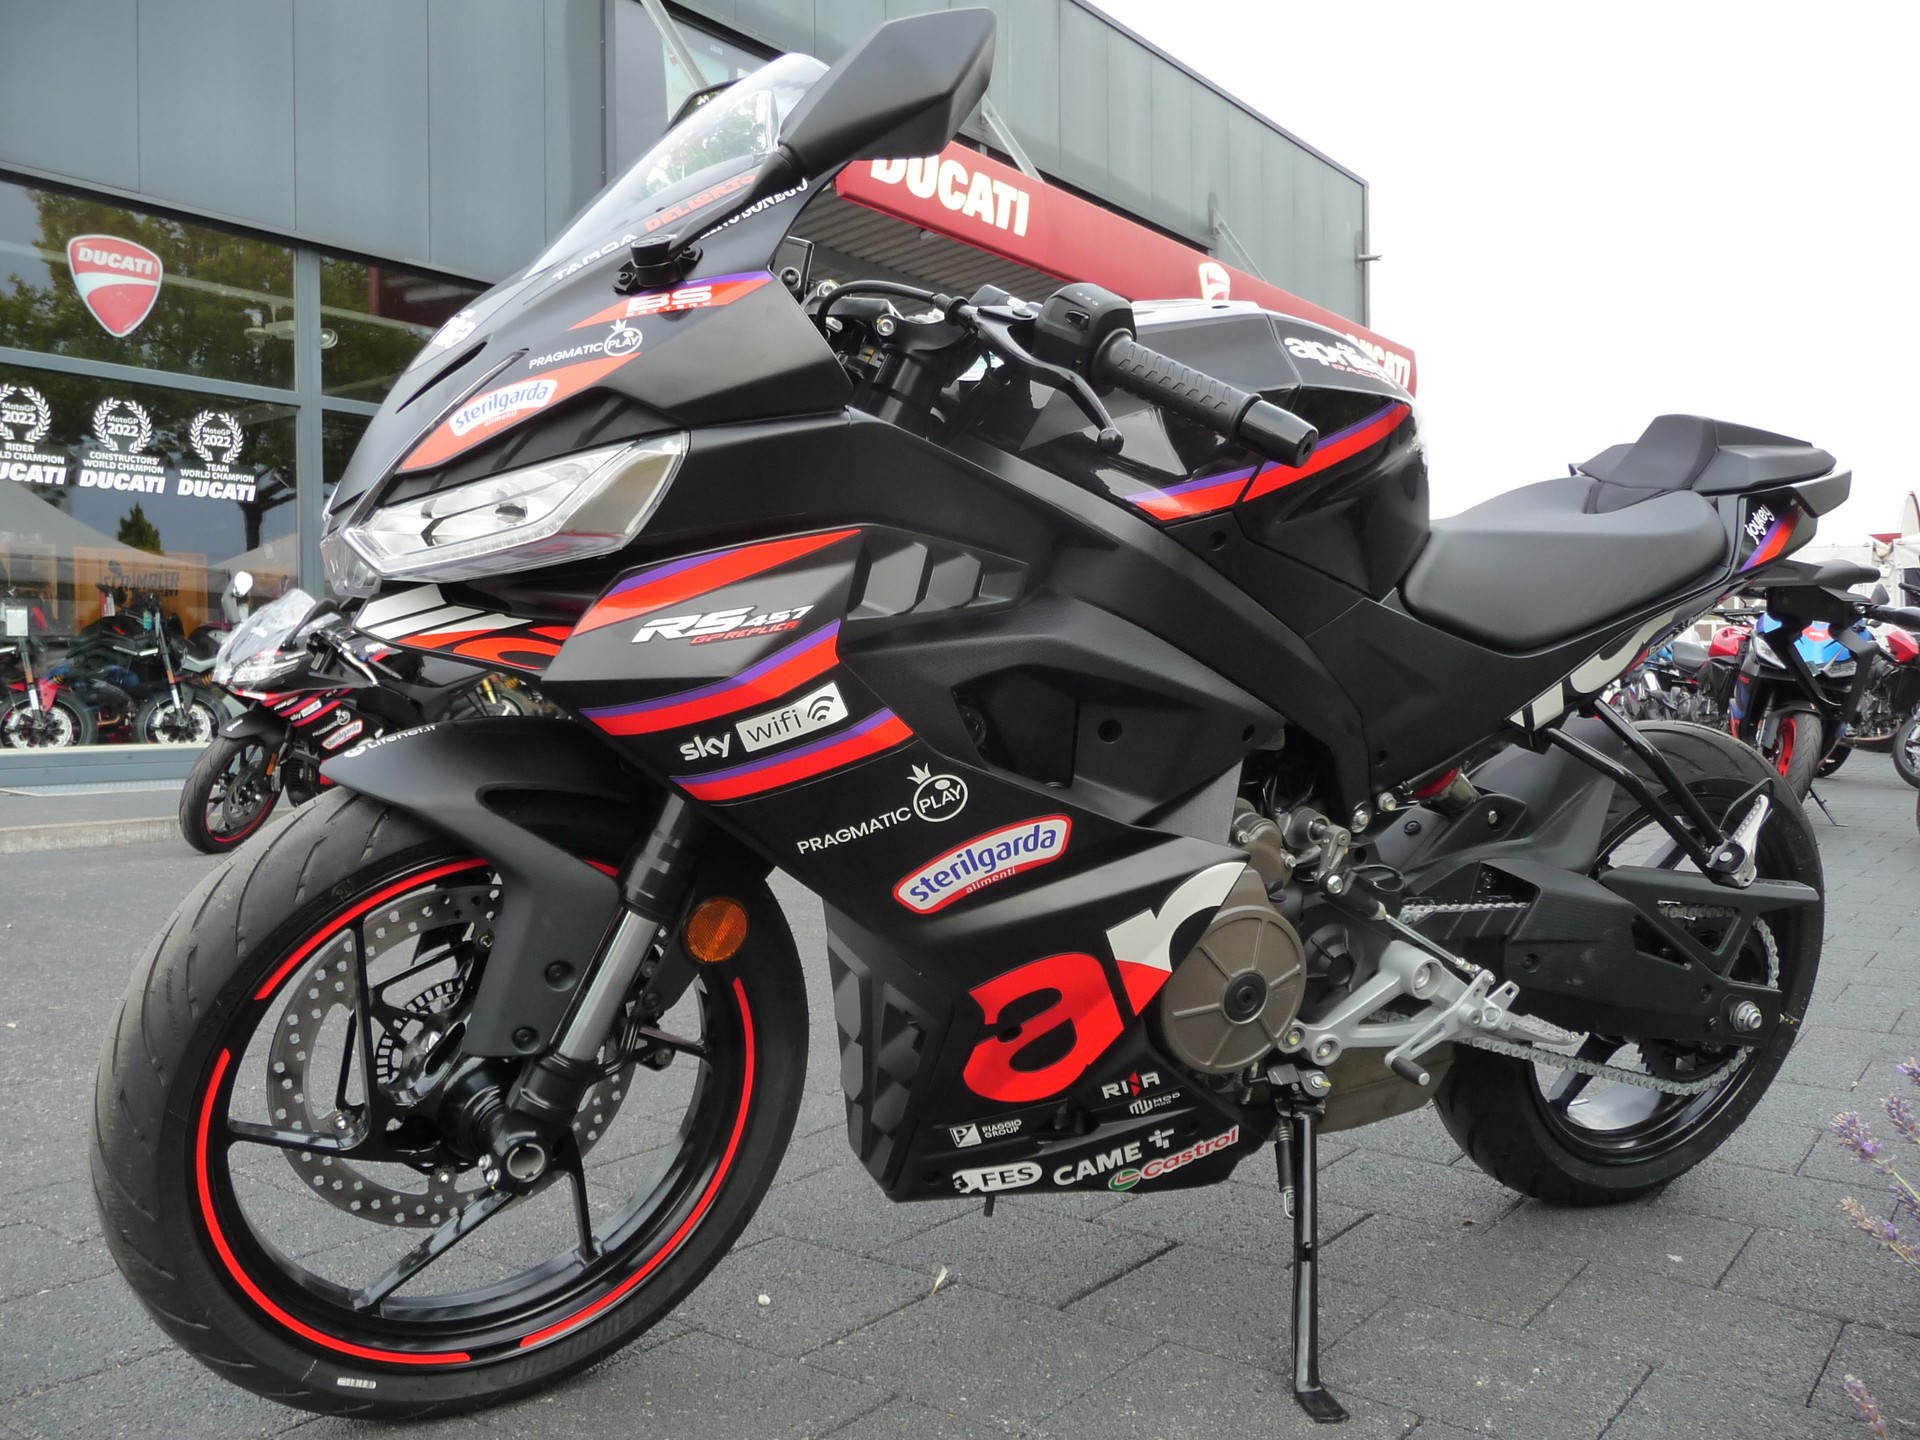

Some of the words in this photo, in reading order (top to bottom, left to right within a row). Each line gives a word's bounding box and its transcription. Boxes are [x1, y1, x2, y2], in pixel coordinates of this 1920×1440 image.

[78, 246, 153, 275] DUCATI
[626, 286, 712, 313] BS
[528, 342, 603, 369] PRAGMATIC
[607, 335, 639, 349] PLAY
[2, 403, 36, 412] MotoGP
[455, 382, 549, 429] sterilgarda
[2, 410, 36, 425] 2022
[107, 415, 139, 425] MotoGP
[484, 411, 517, 427] alimenti
[107, 423, 139, 437] 2022
[202, 426, 231, 436] MotoGP
[5, 442, 35, 453] RIDER
[202, 434, 231, 447] 2022
[13, 452, 65, 464] CHAMPION
[83, 459, 116, 470] WORLD
[117, 462, 164, 474] CHAMPION
[206, 463, 229, 473] TEAM
[79, 470, 166, 494] DUCATI
[180, 469, 210, 479] WORLD
[211, 472, 255, 483] CHAMPION
[177, 479, 256, 502] DUCATI
[680, 733, 731, 761] sky
[746, 709, 802, 743] wifi
[796, 806, 912, 854] PRAGMATIC
[918, 784, 961, 814] PLAY
[909, 824, 1057, 902] sterilgarda
[966, 866, 1016, 894] alimenti
[982, 1119, 1022, 1133] PIAGGIO
[984, 1126, 1020, 1138] GROUP
[1143, 1125, 1239, 1180] Castrol
[1053, 1141, 1143, 1186] CAME
[983, 1166, 1035, 1189] FES
